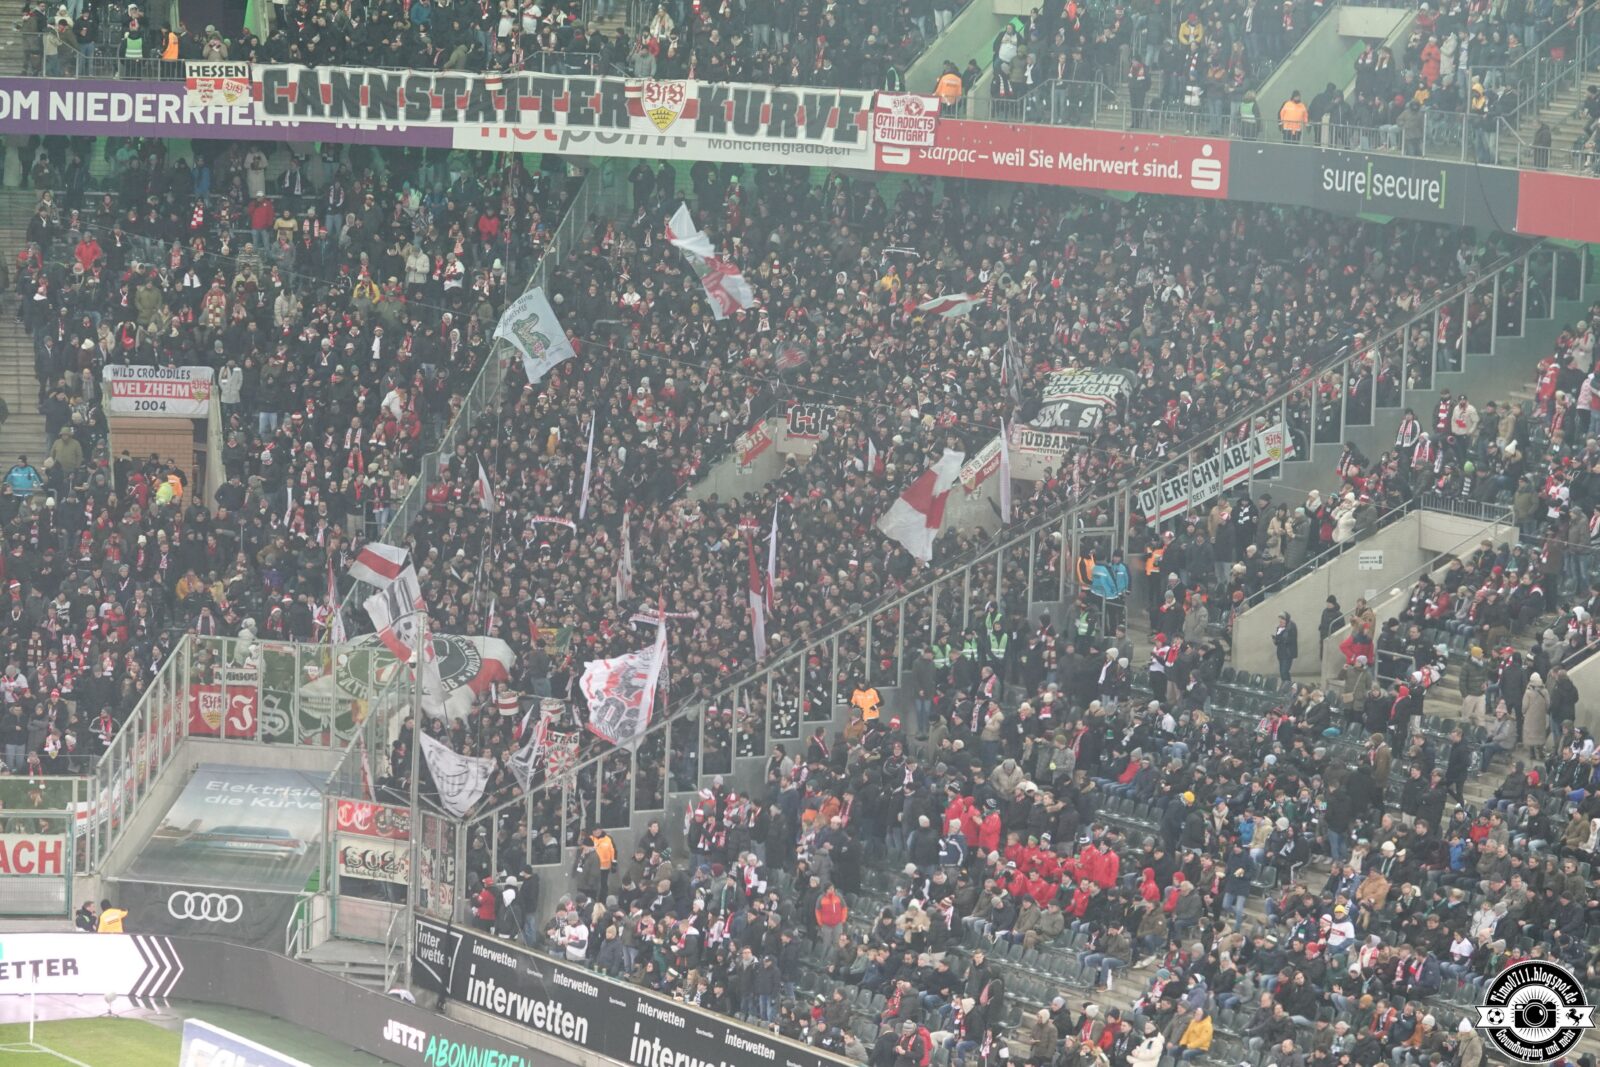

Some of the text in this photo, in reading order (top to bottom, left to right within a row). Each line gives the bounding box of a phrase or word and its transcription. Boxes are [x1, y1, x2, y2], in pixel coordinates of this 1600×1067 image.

[189, 65, 246, 78] HESSEN
[694, 85, 864, 143] KURVE
[897, 116, 934, 130] ADDICTS
[880, 128, 928, 142] STUTTGART
[992, 148, 1025, 167] weil
[1028, 149, 1054, 169] Sie
[1058, 151, 1139, 176] Mehrwert
[1142, 158, 1183, 179] sind.
[112, 367, 191, 380] WILD CROCODILES
[113, 381, 190, 397] WELZHEIM
[135, 400, 167, 411] 2004
[204, 795, 246, 806] die
[418, 928, 441, 948] inter
[473, 939, 517, 969] interwetten
[553, 968, 599, 998] interwetten
[466, 963, 588, 1044] interwetten
[637, 997, 685, 1028] interwetten
[383, 1018, 426, 1053] JETZT
[725, 1029, 776, 1060] interwetten
